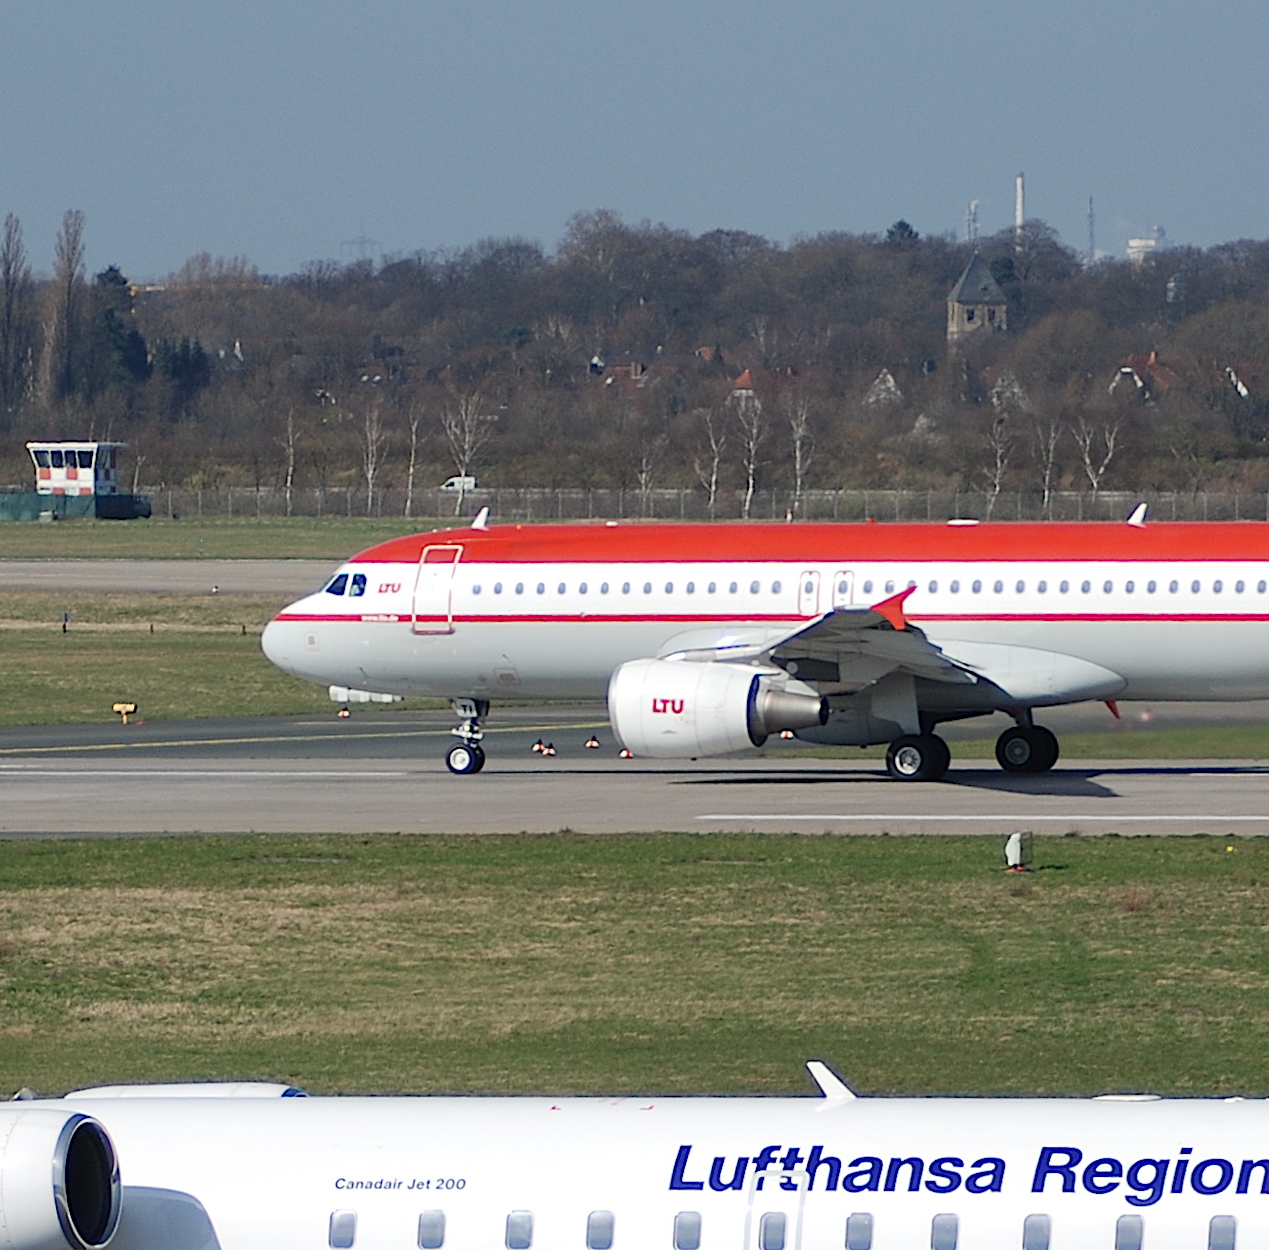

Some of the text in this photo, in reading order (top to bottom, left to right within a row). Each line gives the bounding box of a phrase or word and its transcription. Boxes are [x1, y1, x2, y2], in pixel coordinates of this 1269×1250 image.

[377, 582, 402, 594] LTU
[652, 698, 684, 714] LTU
[669, 1144, 1006, 1194] Lufthansa
[335, 1177, 467, 1190] Canadair Jet 200
